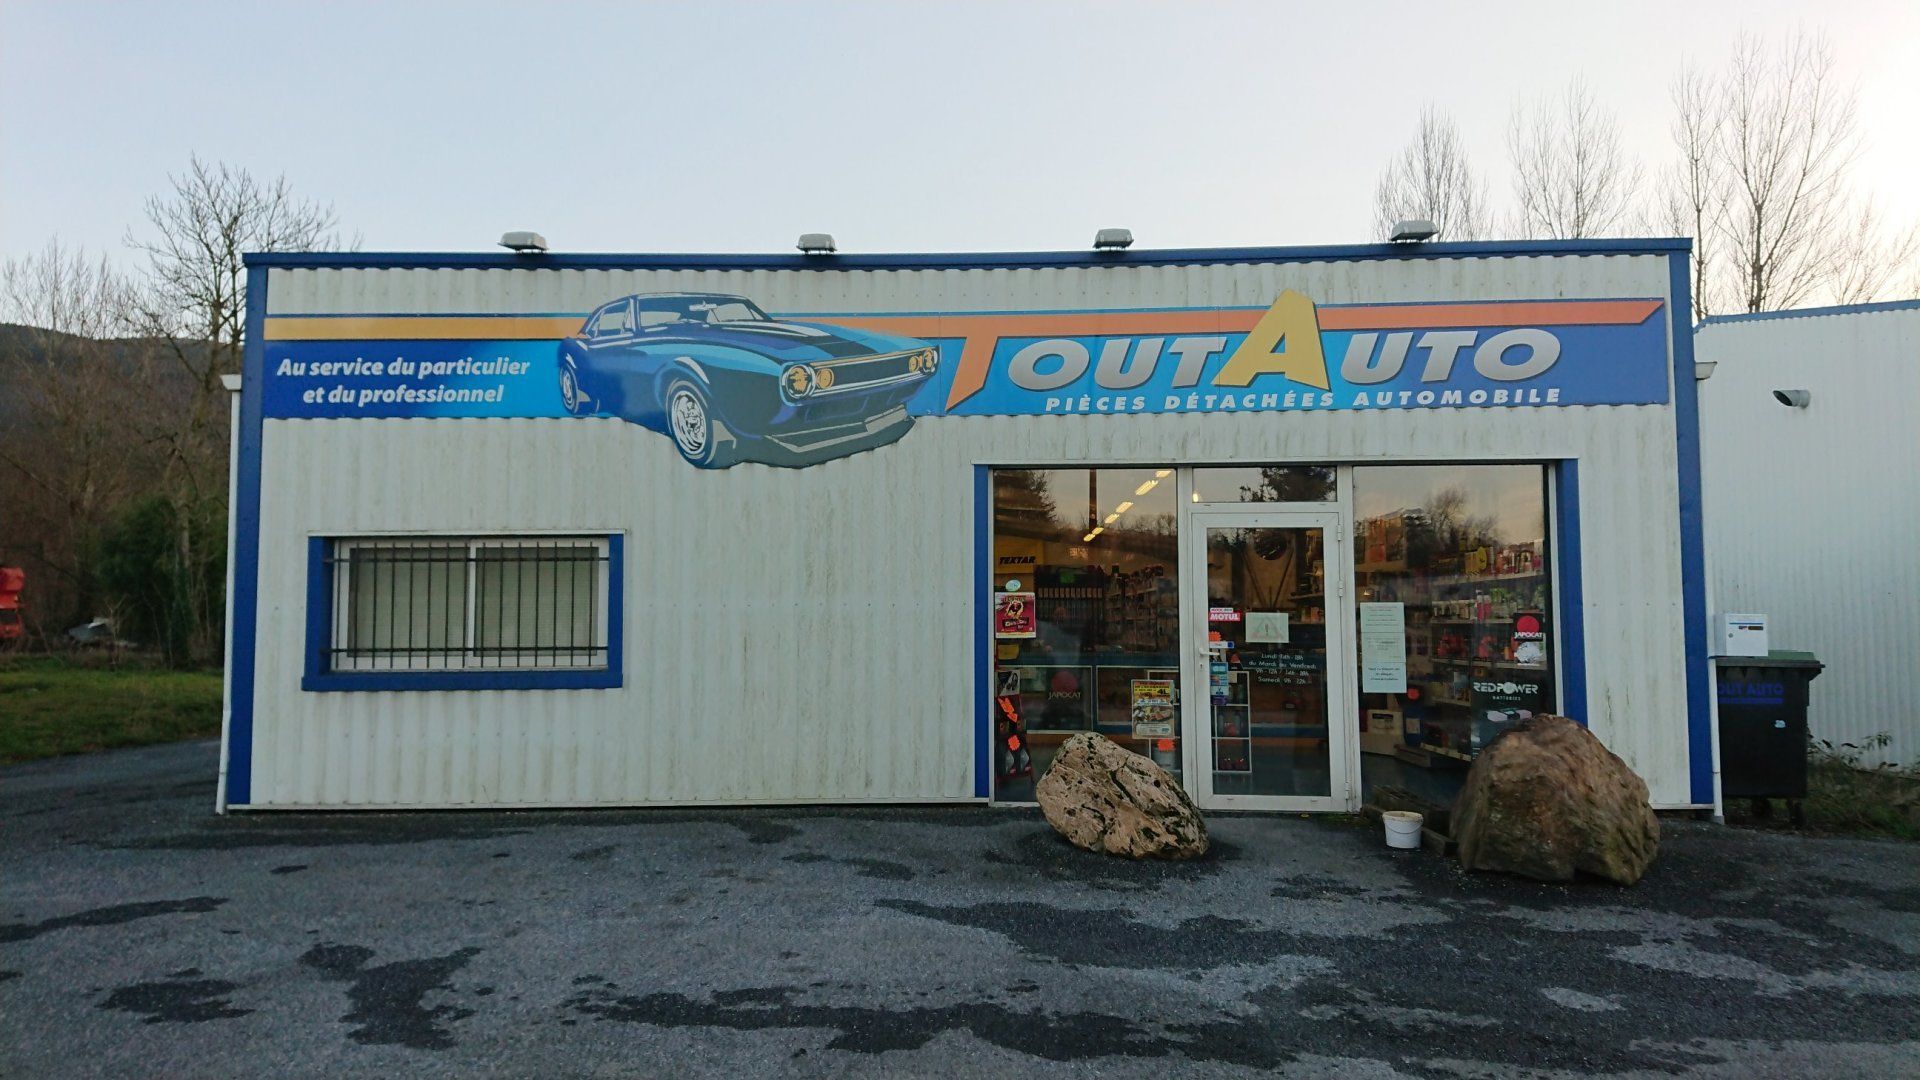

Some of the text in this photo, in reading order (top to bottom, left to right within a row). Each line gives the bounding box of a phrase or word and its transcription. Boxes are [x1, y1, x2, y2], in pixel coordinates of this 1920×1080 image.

[277, 356, 530, 379] Au service du particulier
[303, 384, 505, 407] et du professionnel
[1046, 387, 1561, 412] PIÈCES DÉTACHÉES AUTOMOBILE
[1000, 556, 1036, 565] TEXTAR
[1514, 631, 1543, 639] JAPOCAT
[1746, 683, 1784, 695] AUTO
[1048, 691, 1081, 701] JAPOCAT
